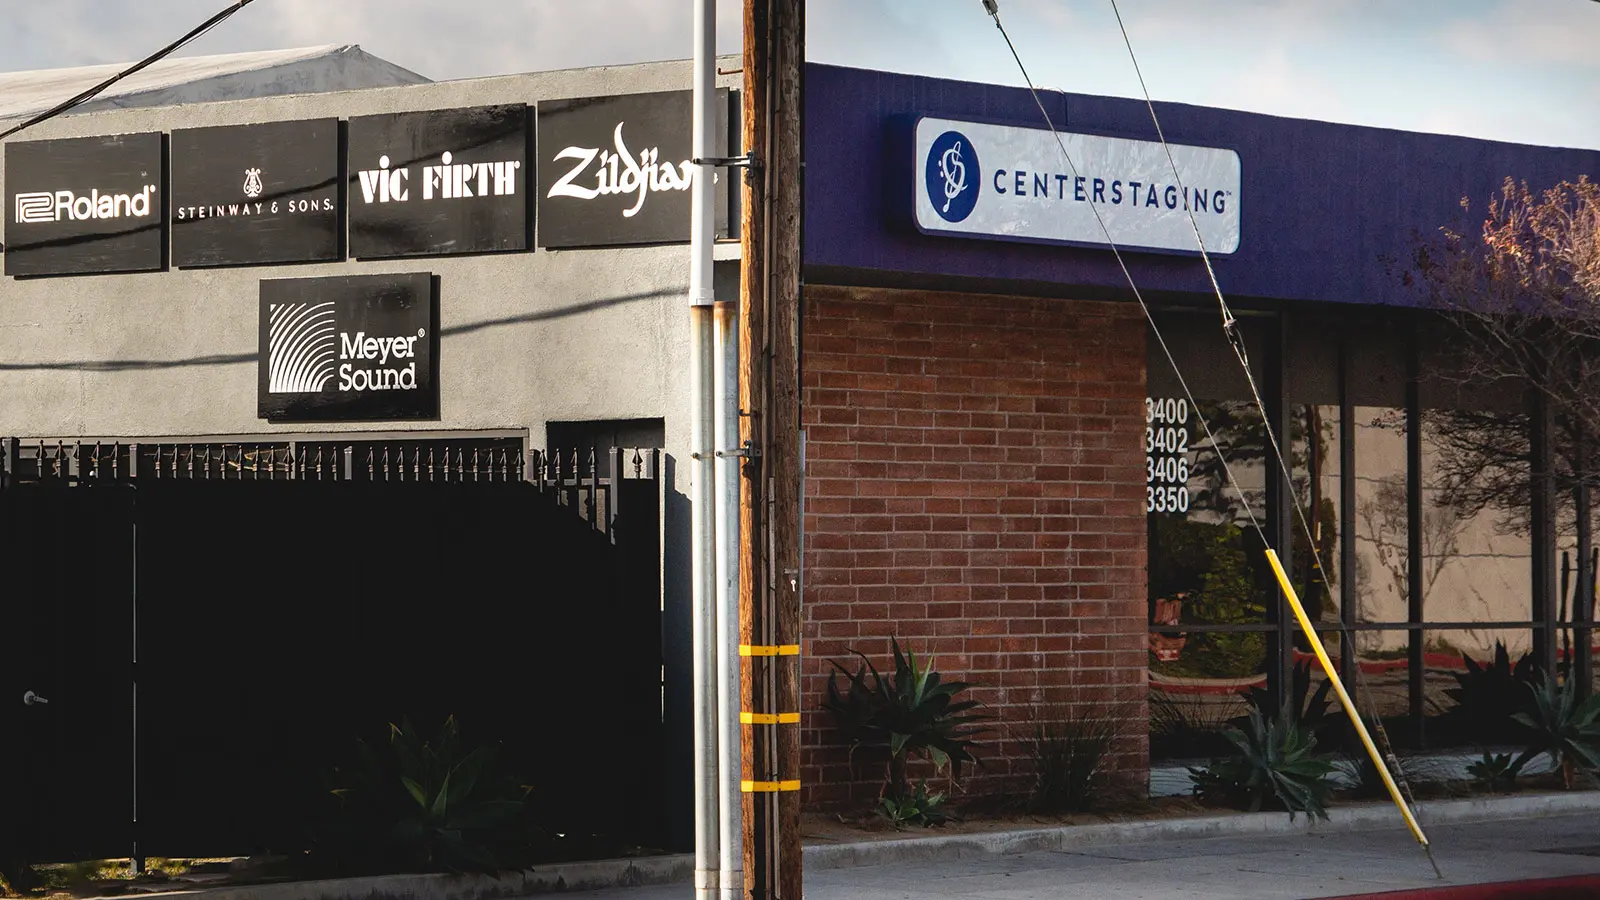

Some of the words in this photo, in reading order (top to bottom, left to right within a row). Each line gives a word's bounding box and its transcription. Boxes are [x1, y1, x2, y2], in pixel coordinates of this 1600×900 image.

[55, 184, 150, 221] Roland
[993, 169, 1225, 214] CENTERSTAGING
[178, 202, 262, 219] STEINWAY
[270, 201, 279, 214] &
[339, 332, 417, 364] Meyer
[338, 362, 418, 391] Sound
[1145, 397, 1188, 424] 3400
[1145, 427, 1188, 453] 3402
[1146, 456, 1188, 483] 3406
[1146, 486, 1188, 512] 3350
